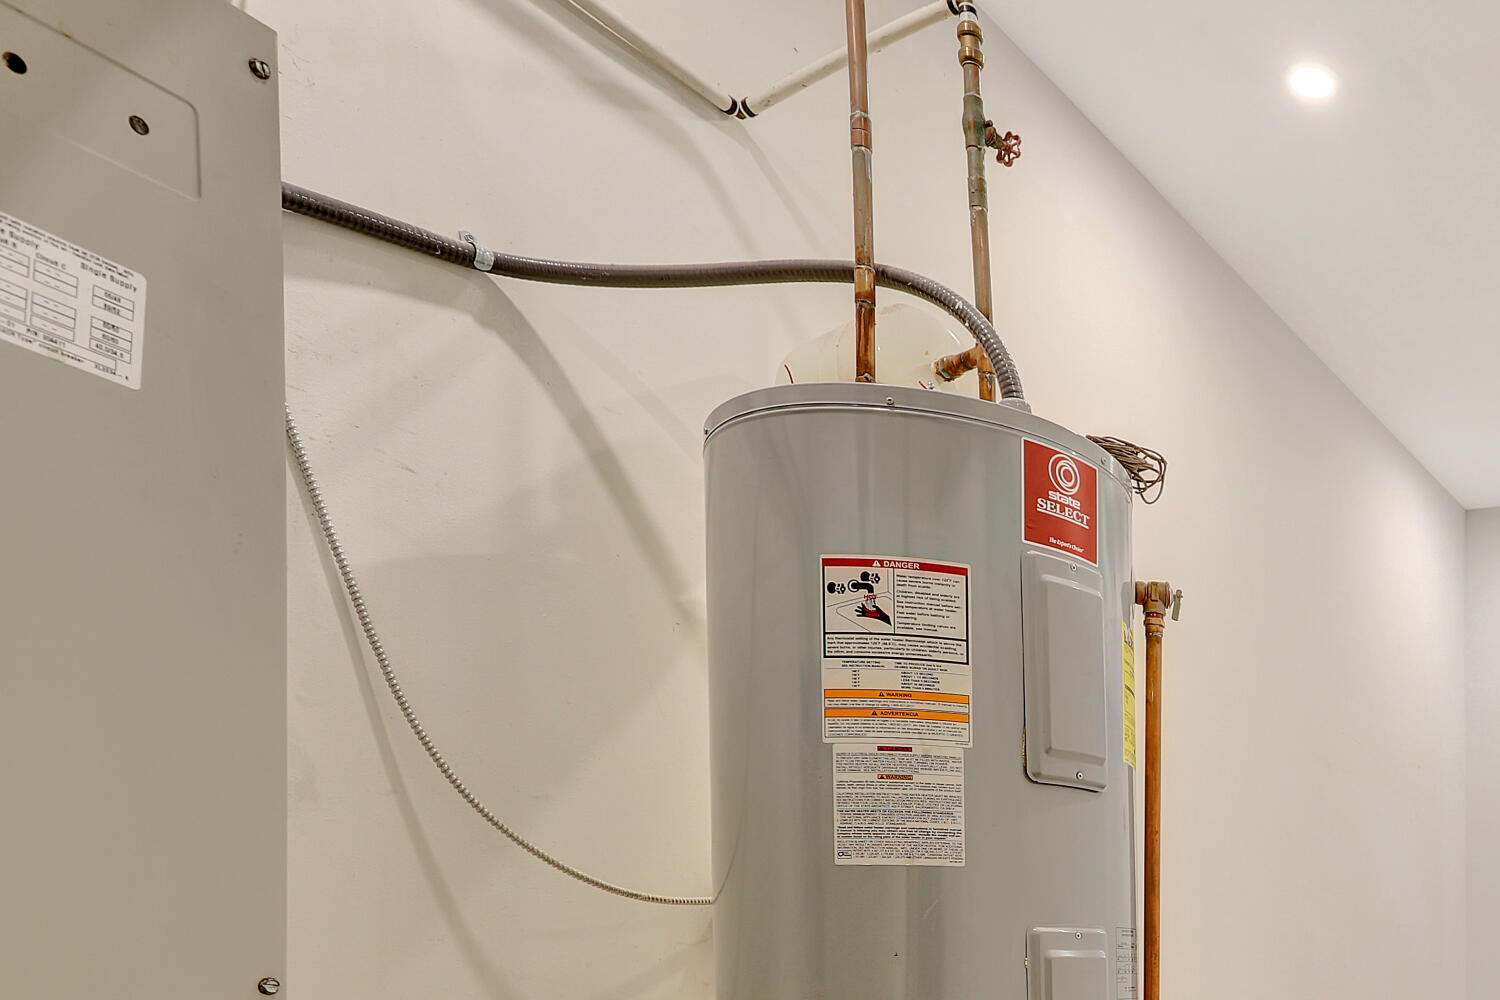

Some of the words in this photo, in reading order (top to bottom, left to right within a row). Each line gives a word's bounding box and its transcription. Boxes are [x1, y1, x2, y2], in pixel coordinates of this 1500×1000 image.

[81, 262, 106, 279] Single
[110, 275, 136, 293] Supply
[1048, 490, 1080, 509] state
[1037, 498, 1090, 525] SELECT
[883, 561, 920, 569] DANGER
